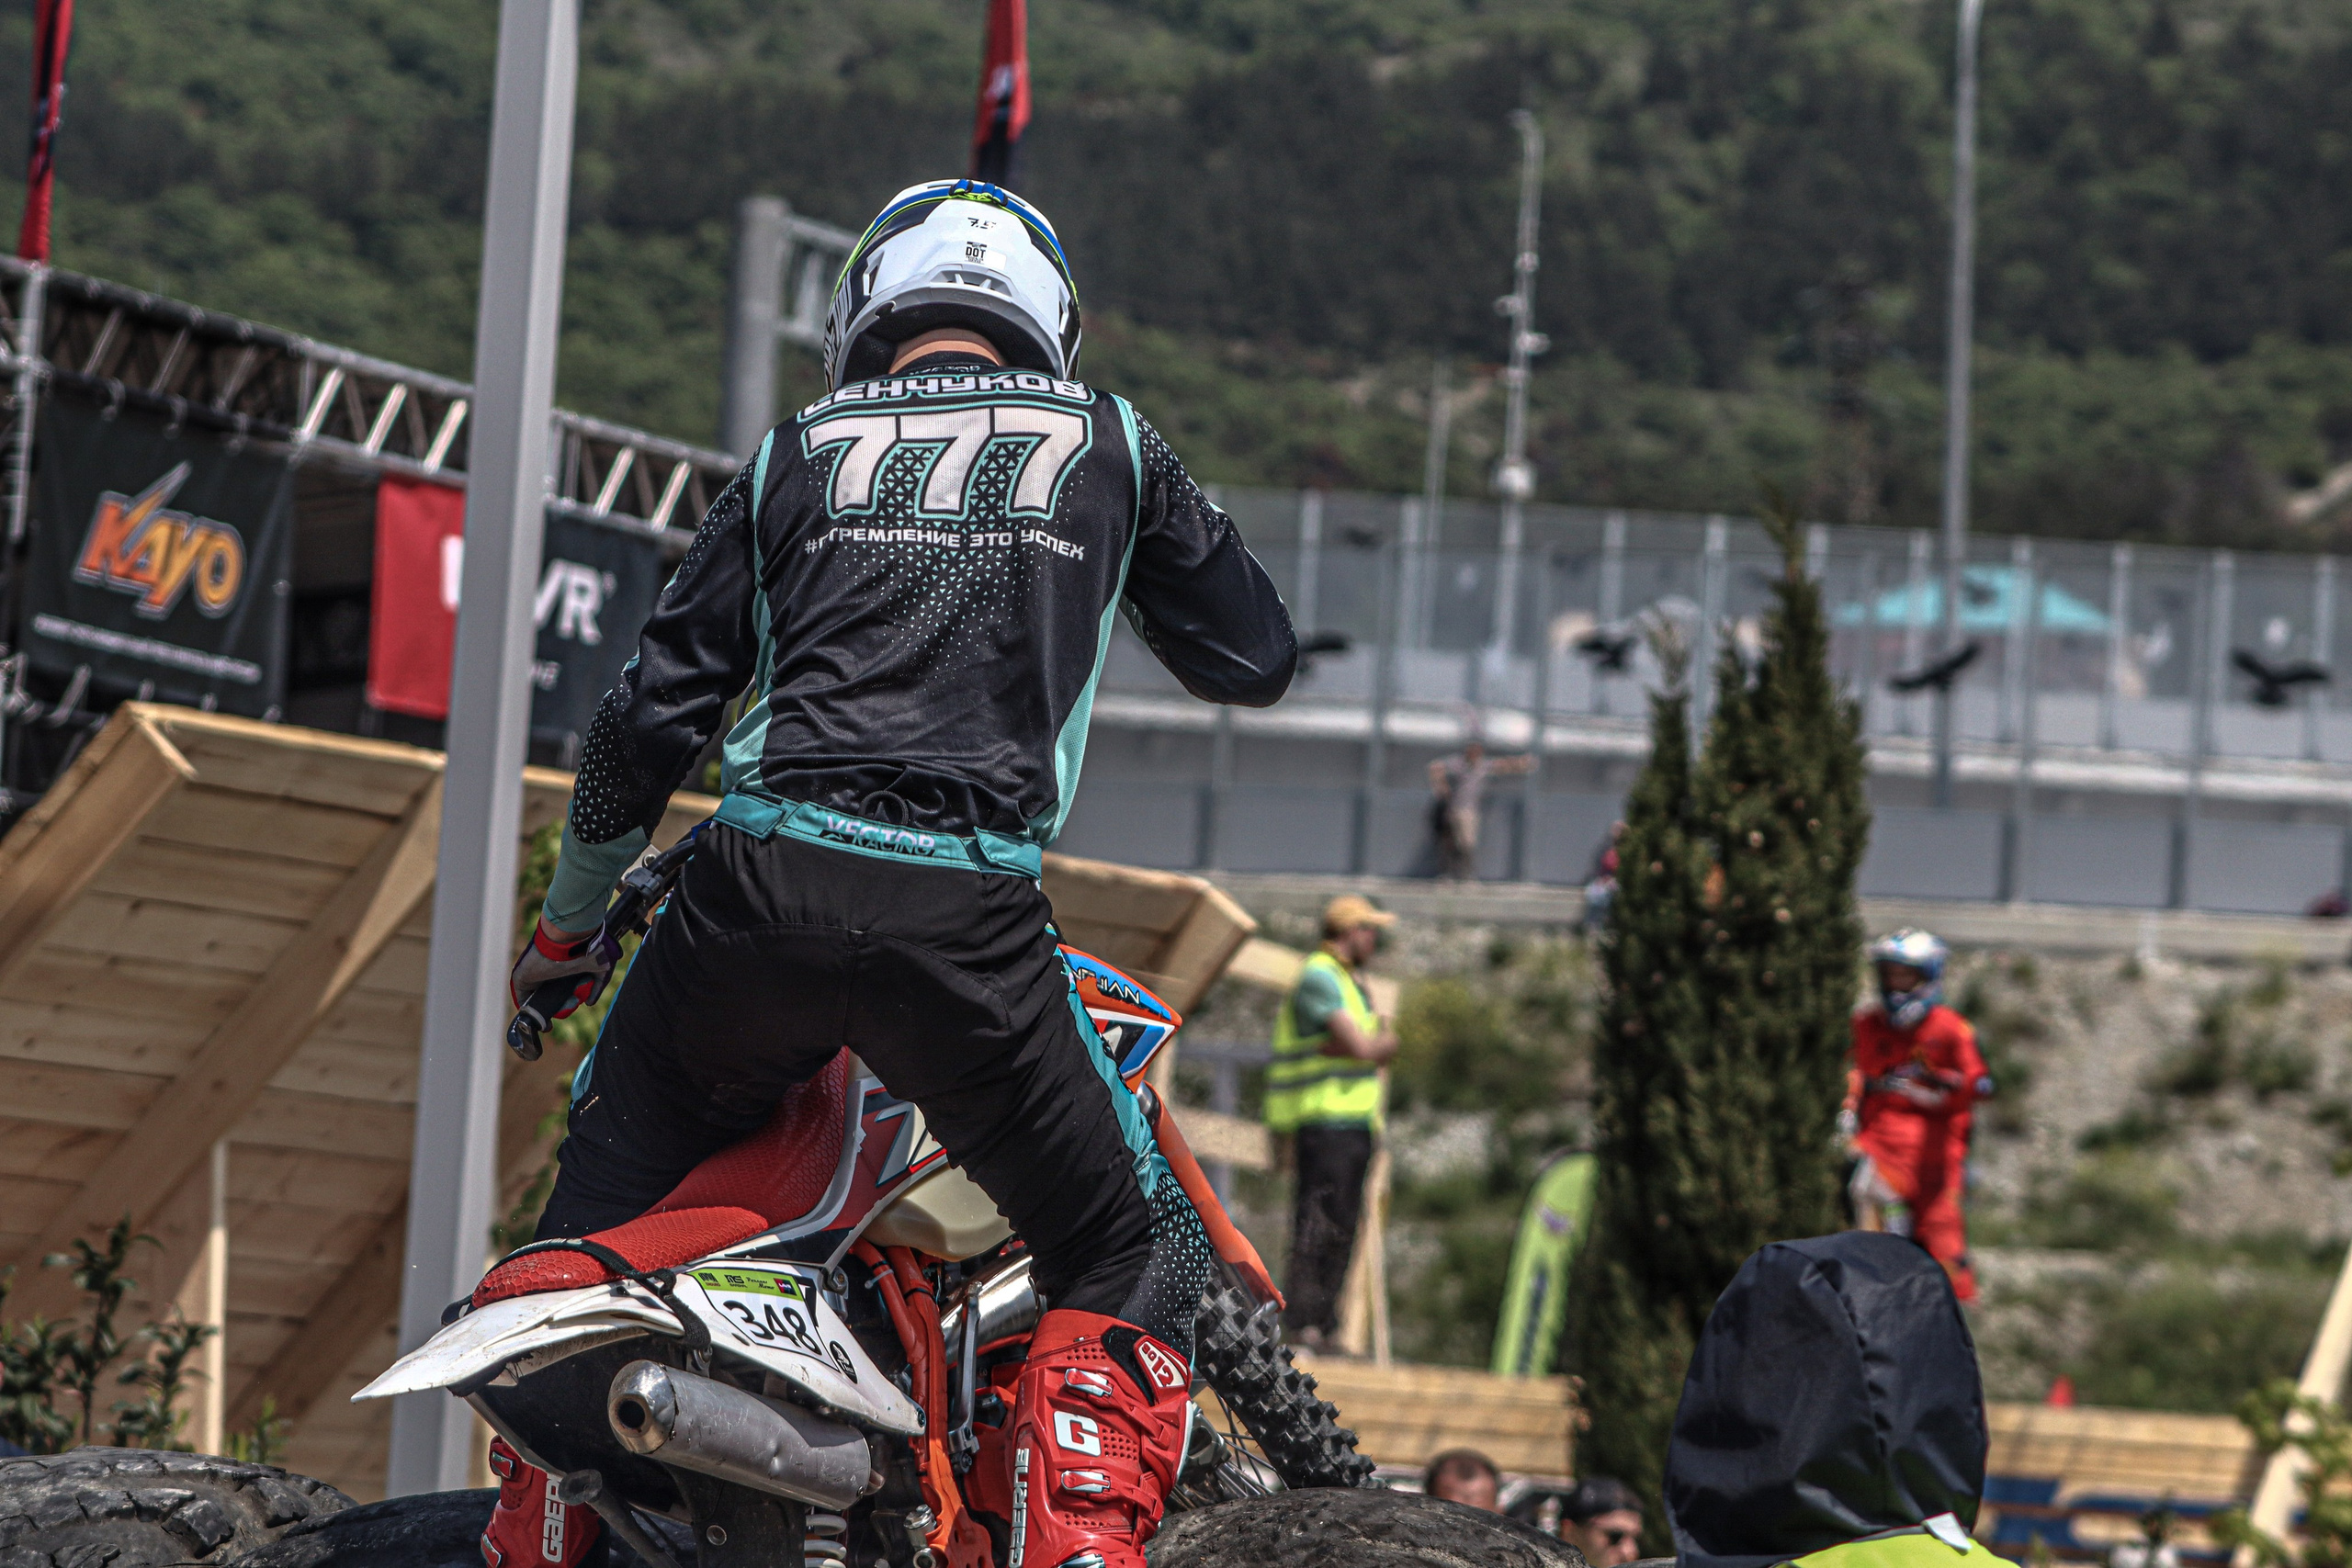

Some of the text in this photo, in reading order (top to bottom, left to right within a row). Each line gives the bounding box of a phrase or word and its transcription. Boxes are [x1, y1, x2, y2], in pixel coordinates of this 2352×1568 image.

[966, 246, 986, 259] DOT
[806, 404, 1088, 515] 777
[74, 459, 246, 621] KAYO
[969, 531, 1013, 547] ЭТО
[1021, 528, 1085, 561] УСПЕХ
[722, 1300, 823, 1356] 348
